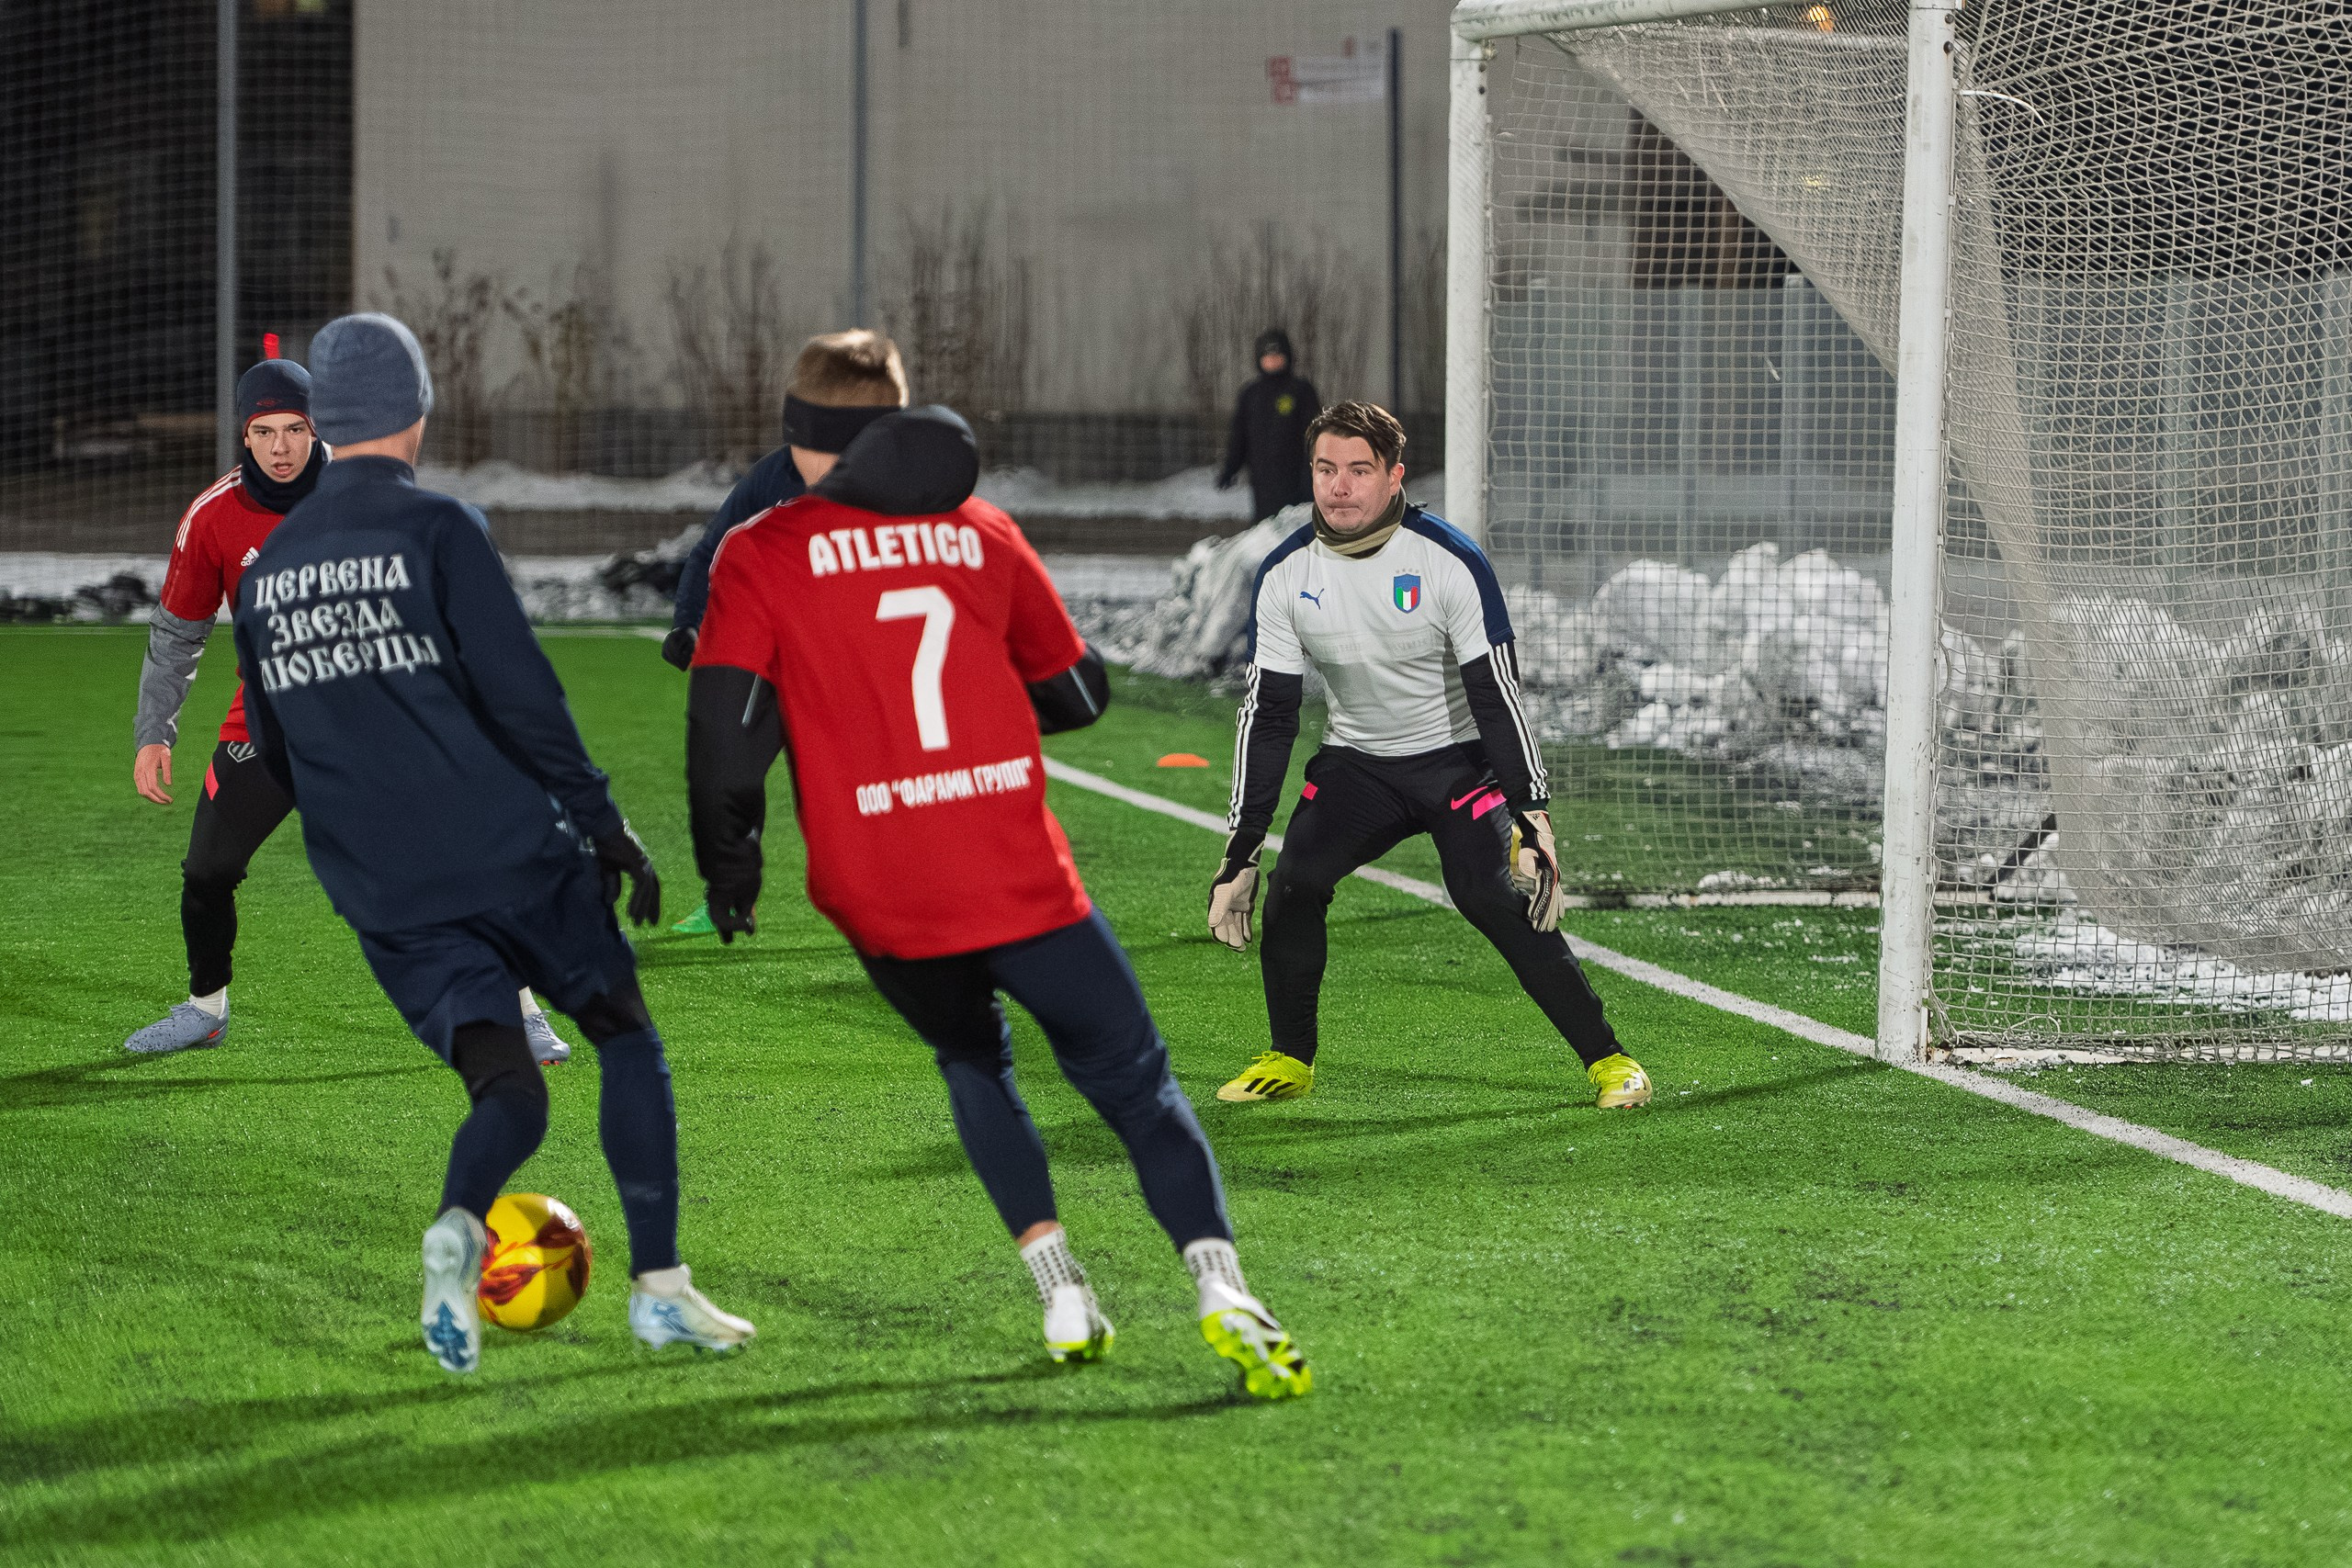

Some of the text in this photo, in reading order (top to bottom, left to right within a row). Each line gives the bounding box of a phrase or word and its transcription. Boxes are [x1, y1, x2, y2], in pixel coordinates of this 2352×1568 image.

[808, 523, 984, 577] ATLETICO
[254, 555, 410, 612] ЦЕРВЕНА
[267, 597, 403, 652] ЗВЕЗДА
[259, 635, 441, 692] ЛЮБЕРЦЫ
[876, 585, 955, 750] 7
[856, 781, 892, 815] ООО
